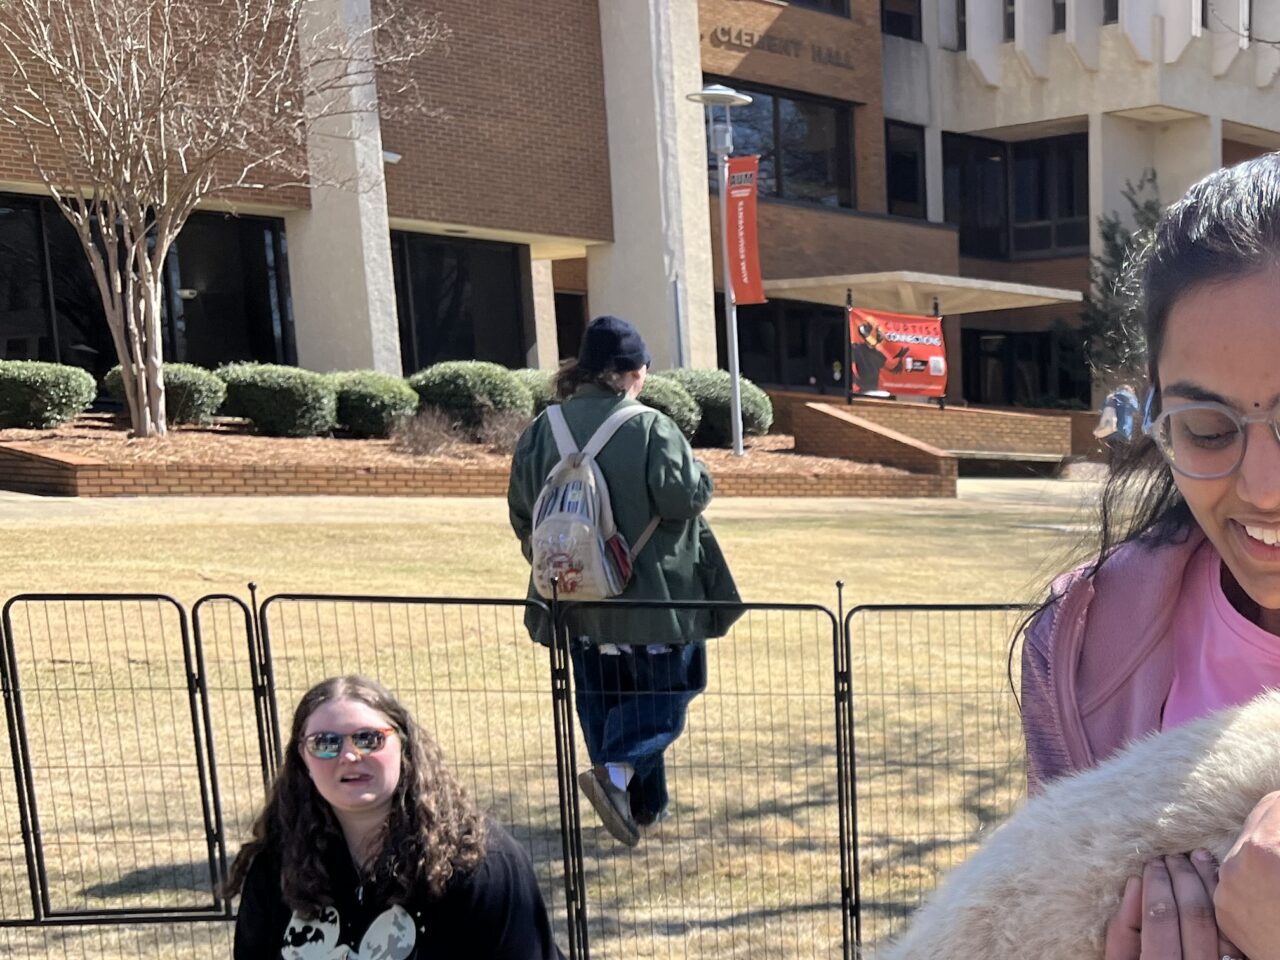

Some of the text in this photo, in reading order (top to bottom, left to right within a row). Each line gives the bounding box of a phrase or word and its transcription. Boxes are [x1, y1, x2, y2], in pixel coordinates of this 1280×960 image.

[714, 26, 854, 69] CLEMENT HALL
[731, 173, 753, 186] AUM
[884, 321, 939, 335] CURTISS
